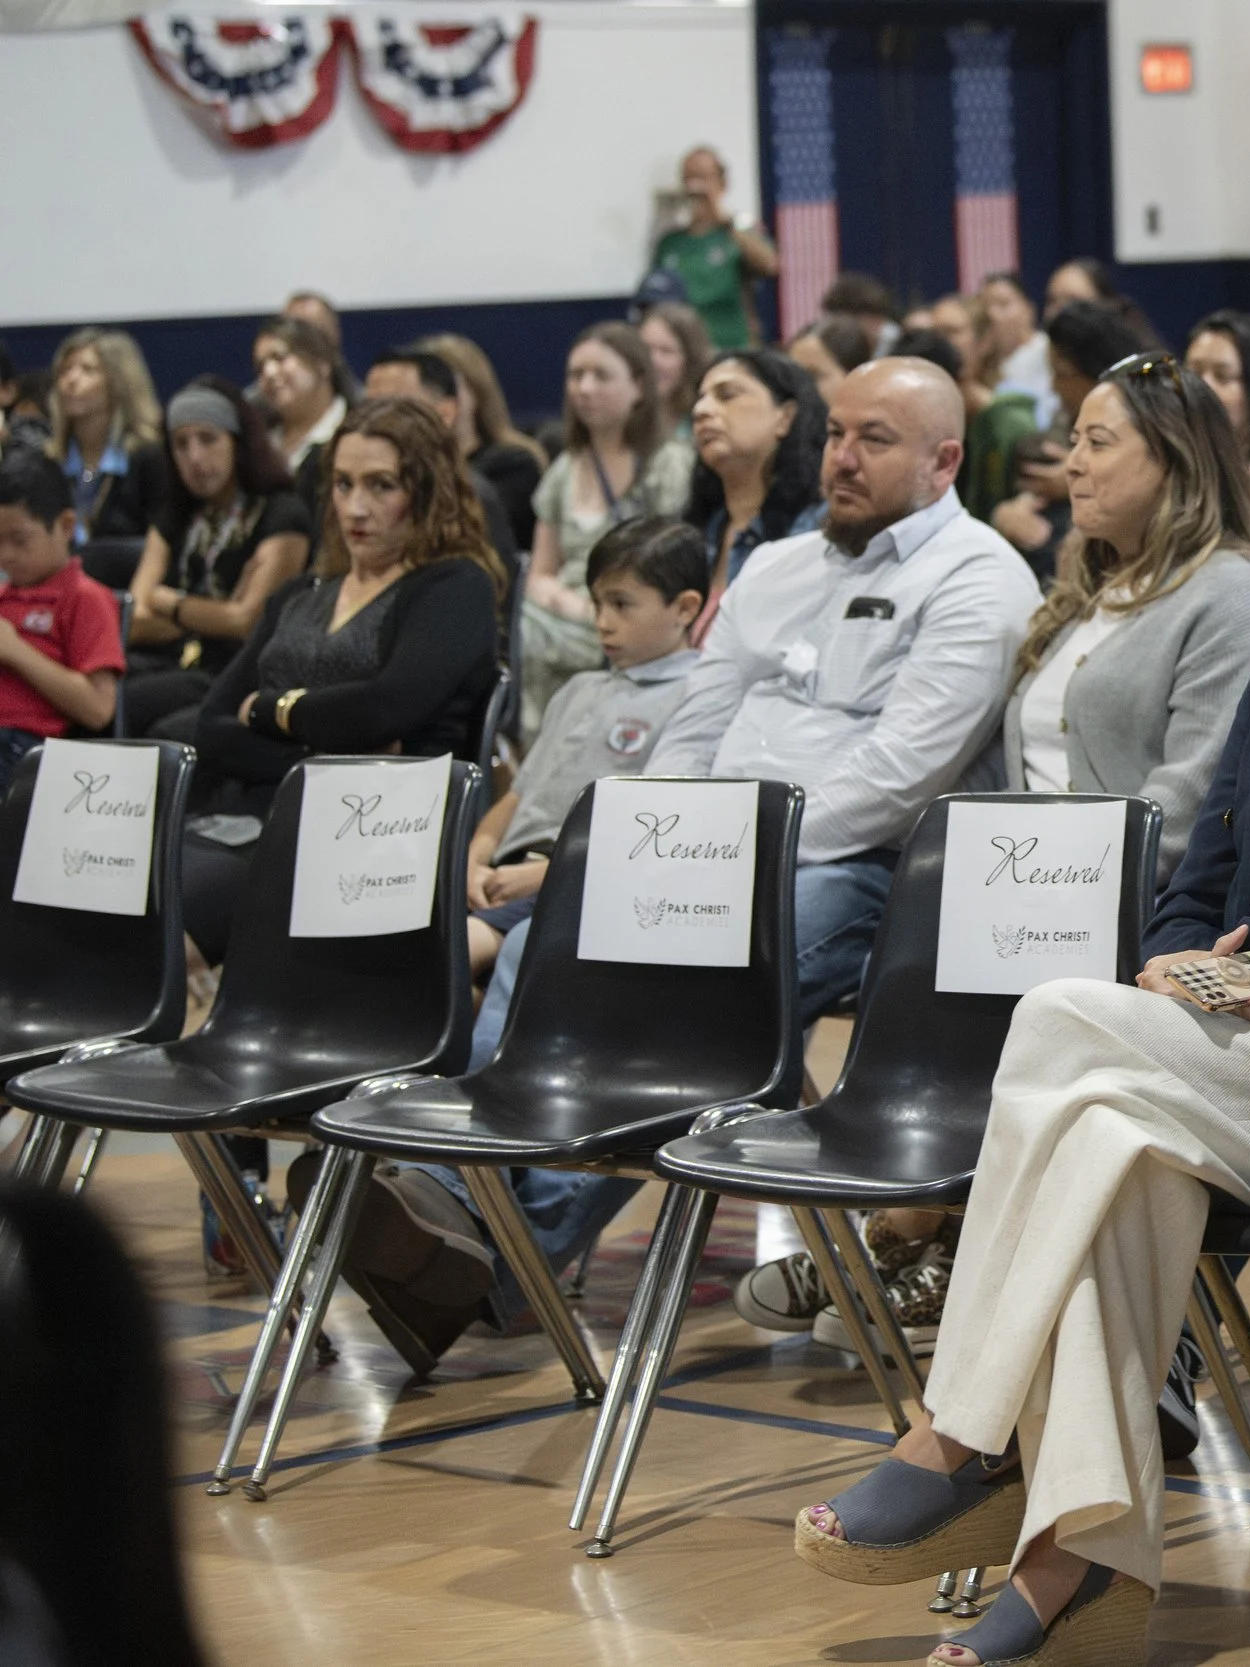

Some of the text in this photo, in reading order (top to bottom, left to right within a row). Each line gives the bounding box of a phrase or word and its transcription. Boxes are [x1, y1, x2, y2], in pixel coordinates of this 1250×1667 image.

[334, 793, 439, 841] Reserved
[628, 812, 749, 861] Reserved
[985, 836, 1111, 886] Reserved
[667, 903, 730, 915] PAX CHRISTI
[1027, 931, 1090, 942] PAX CHRISTI
